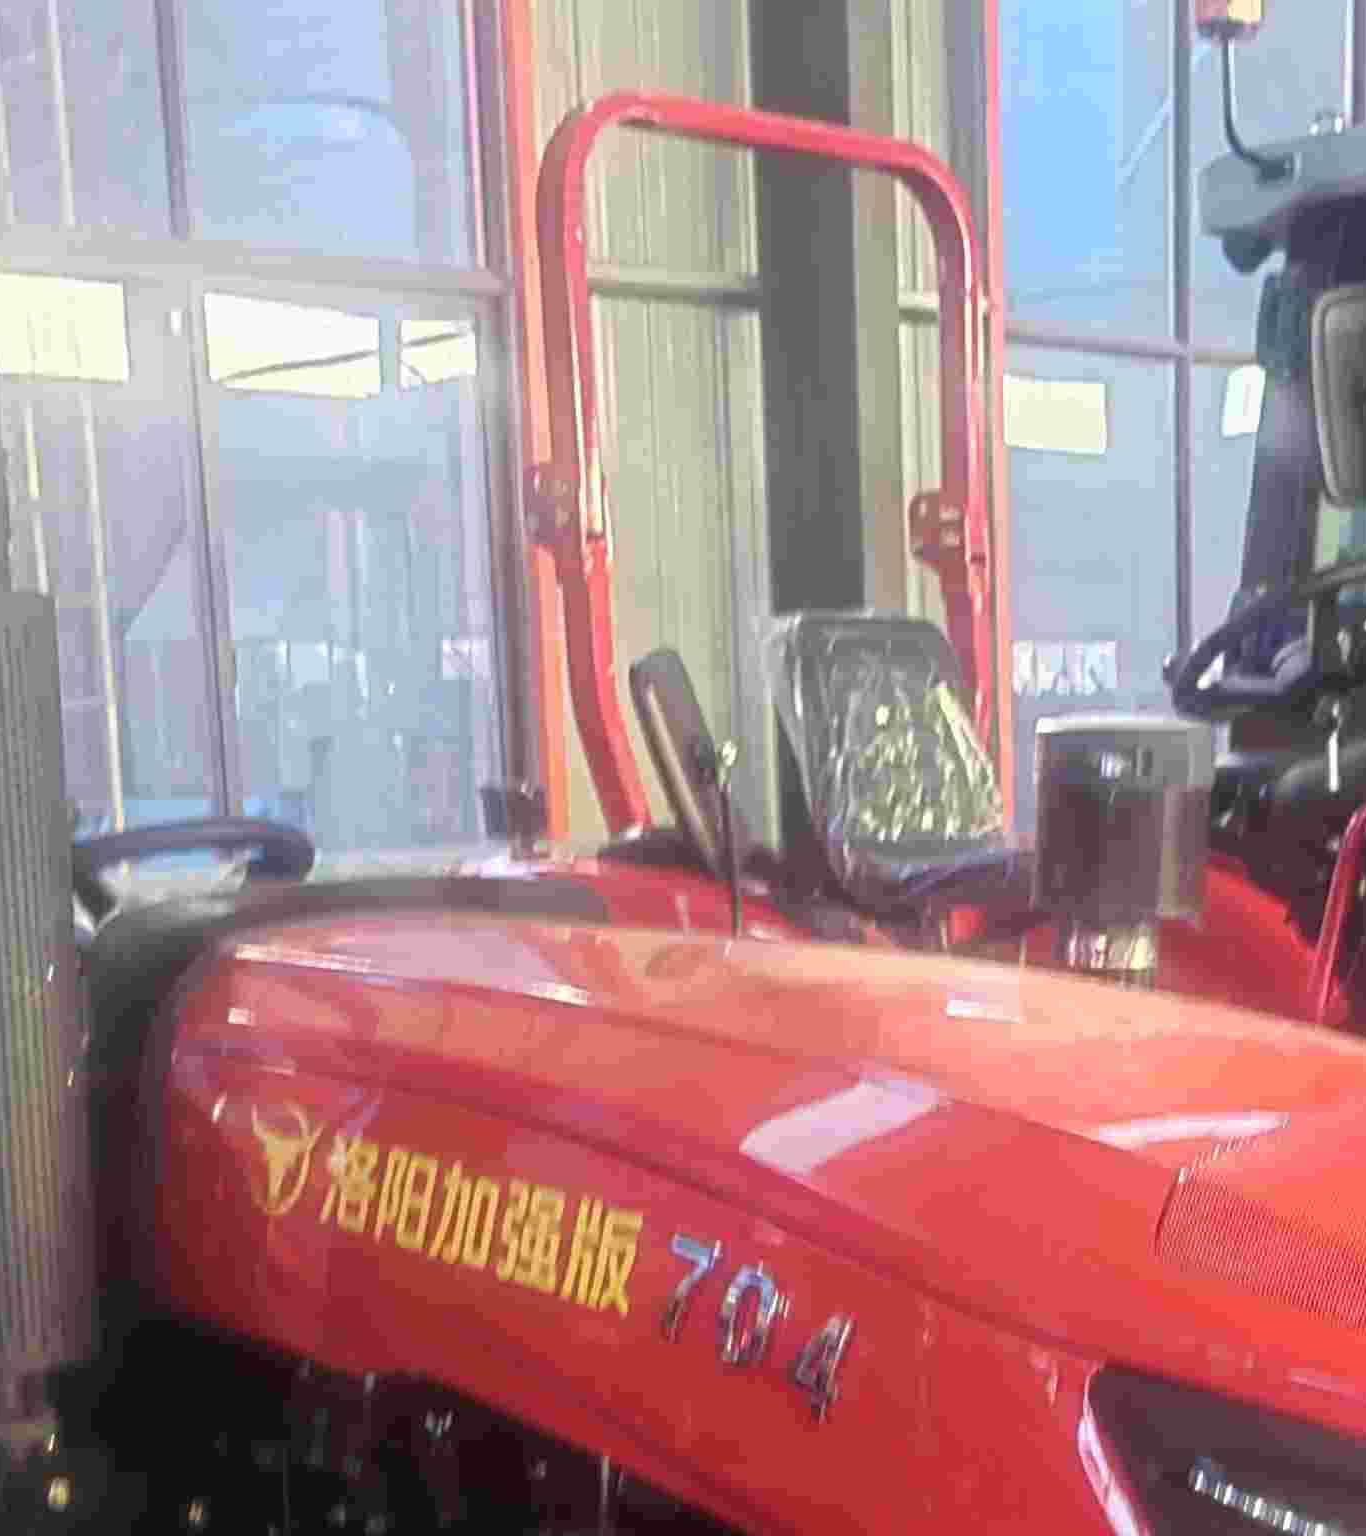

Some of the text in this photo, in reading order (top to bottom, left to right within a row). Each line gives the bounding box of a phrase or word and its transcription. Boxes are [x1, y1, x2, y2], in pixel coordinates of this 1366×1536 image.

[320, 1132, 853, 1422] 洛阳加强版 704
